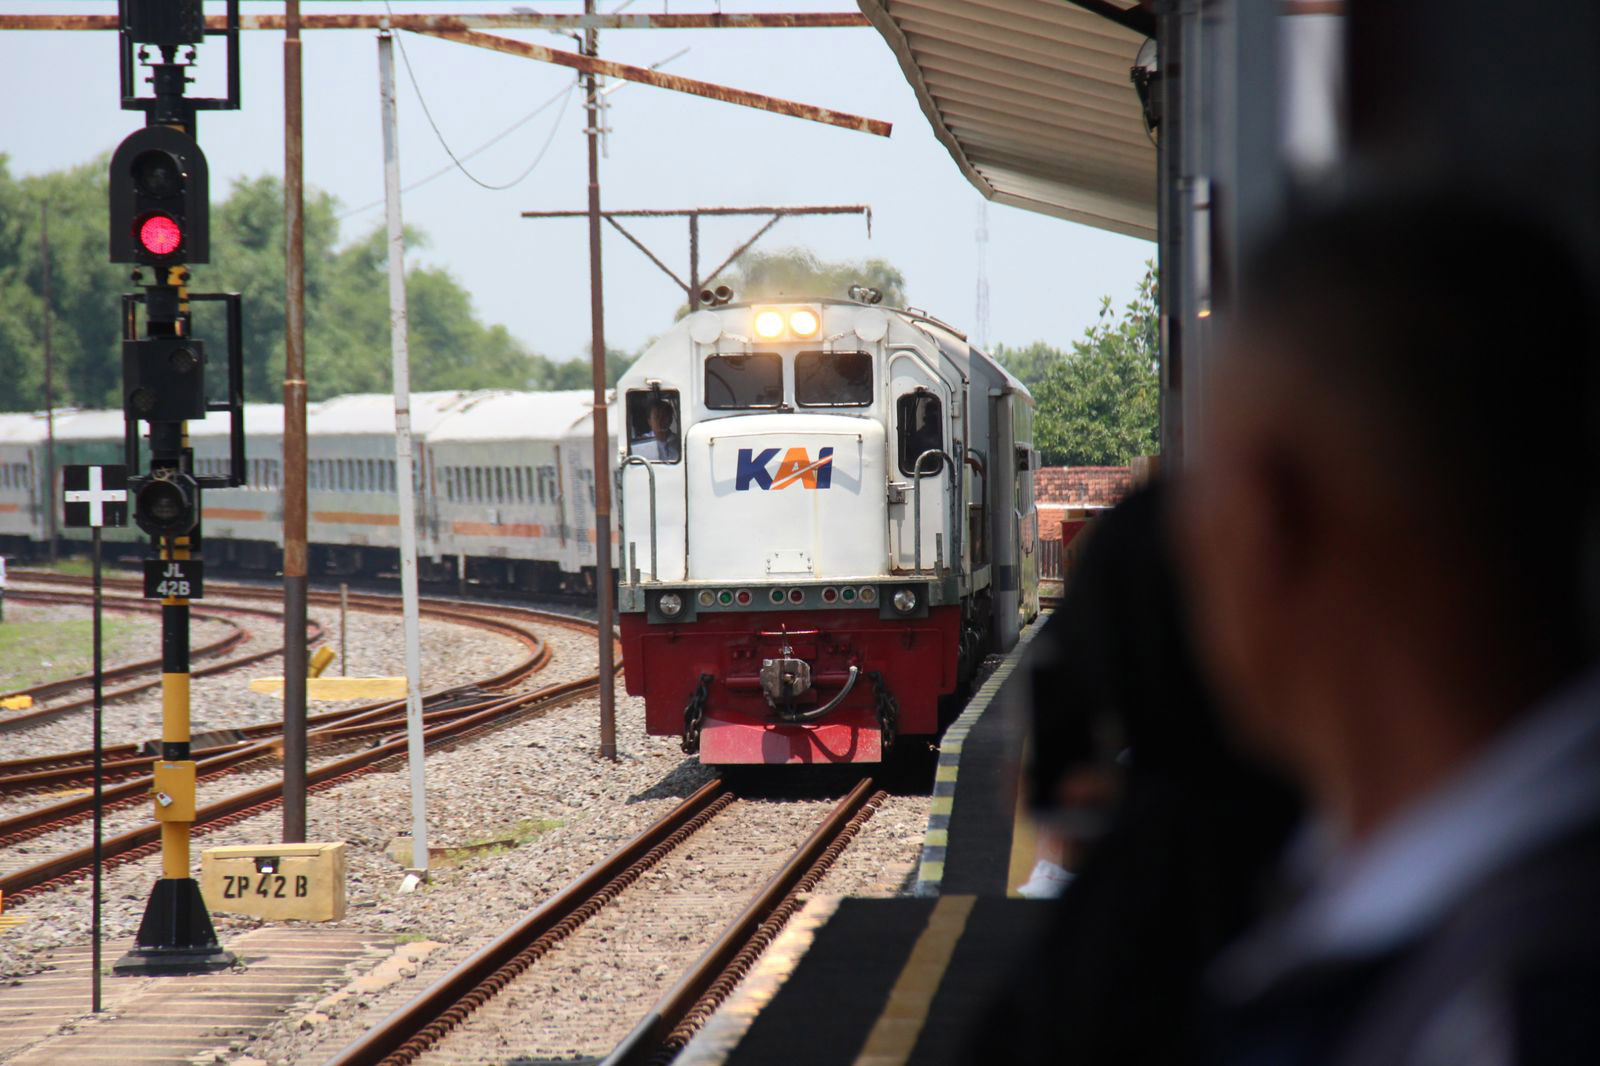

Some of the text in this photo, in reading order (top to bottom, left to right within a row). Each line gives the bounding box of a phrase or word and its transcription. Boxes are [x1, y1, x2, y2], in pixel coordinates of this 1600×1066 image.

[735, 447, 833, 491] KAI
[162, 563, 184, 578] JL
[156, 580, 191, 596] 42B
[223, 875, 250, 899] ZP
